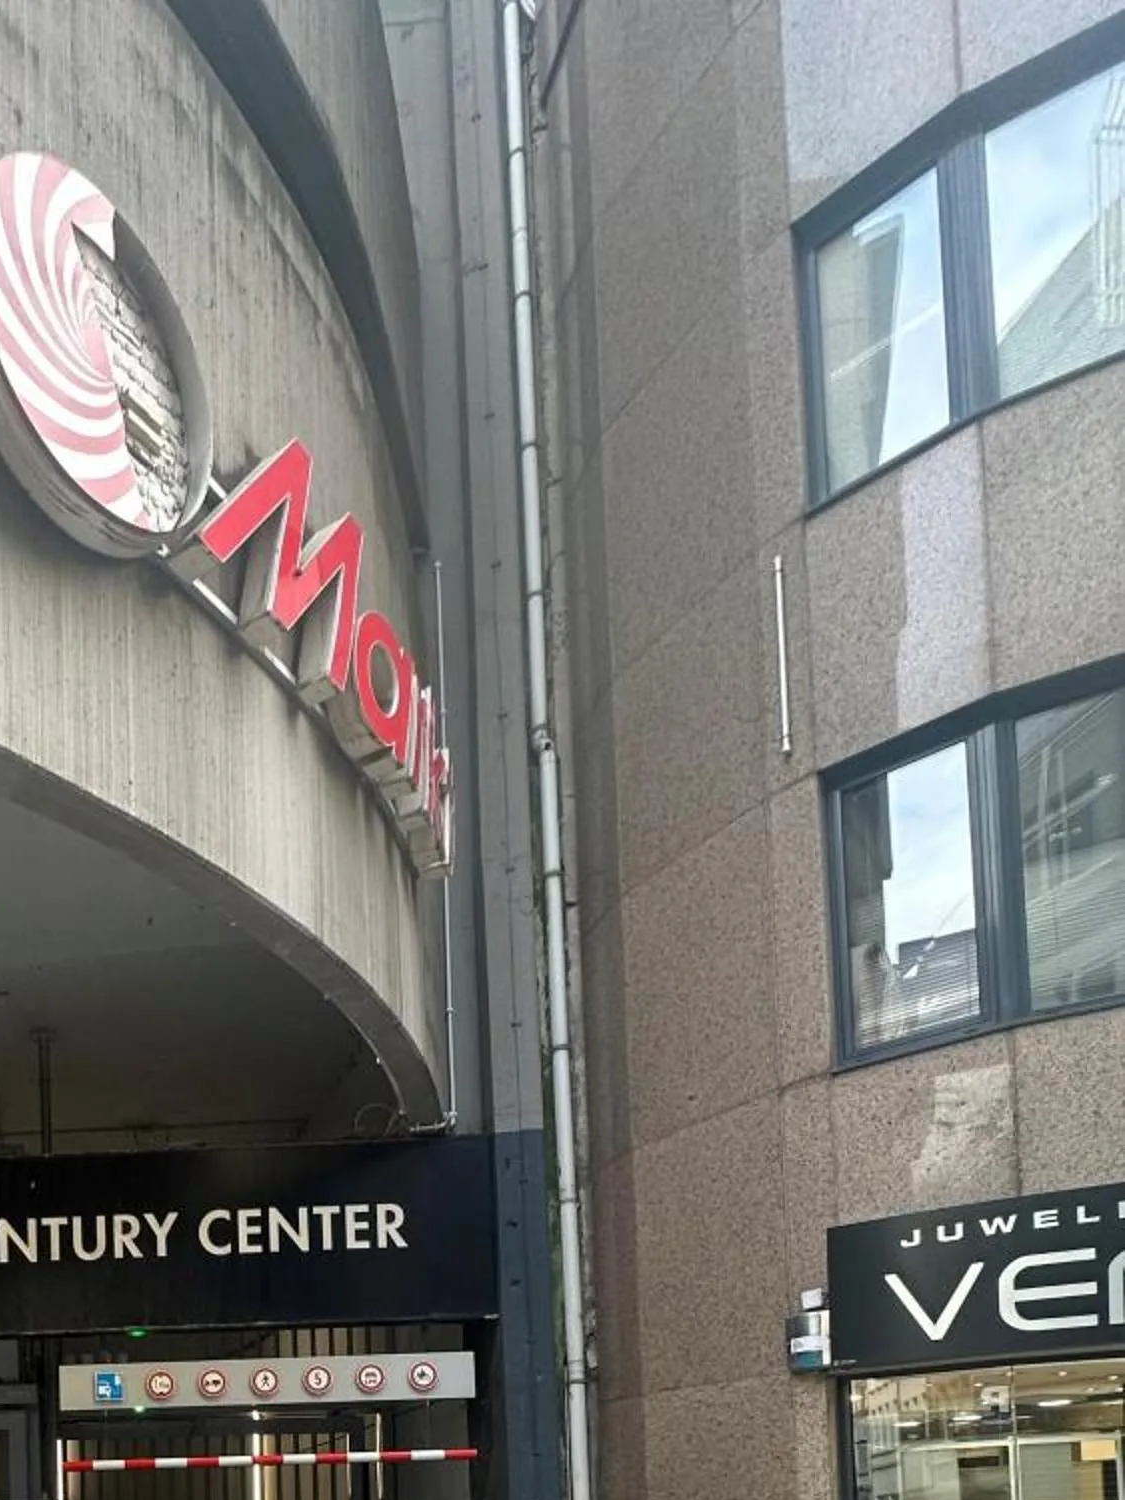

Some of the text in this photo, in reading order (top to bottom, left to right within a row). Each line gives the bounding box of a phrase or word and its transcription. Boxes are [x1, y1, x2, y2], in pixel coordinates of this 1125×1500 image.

[197, 1203, 409, 1257] CENTER
[899, 1201, 1125, 1248] JUWEL
[884, 1247, 1125, 1342] VE
[312, 1373, 322, 1386] 5
